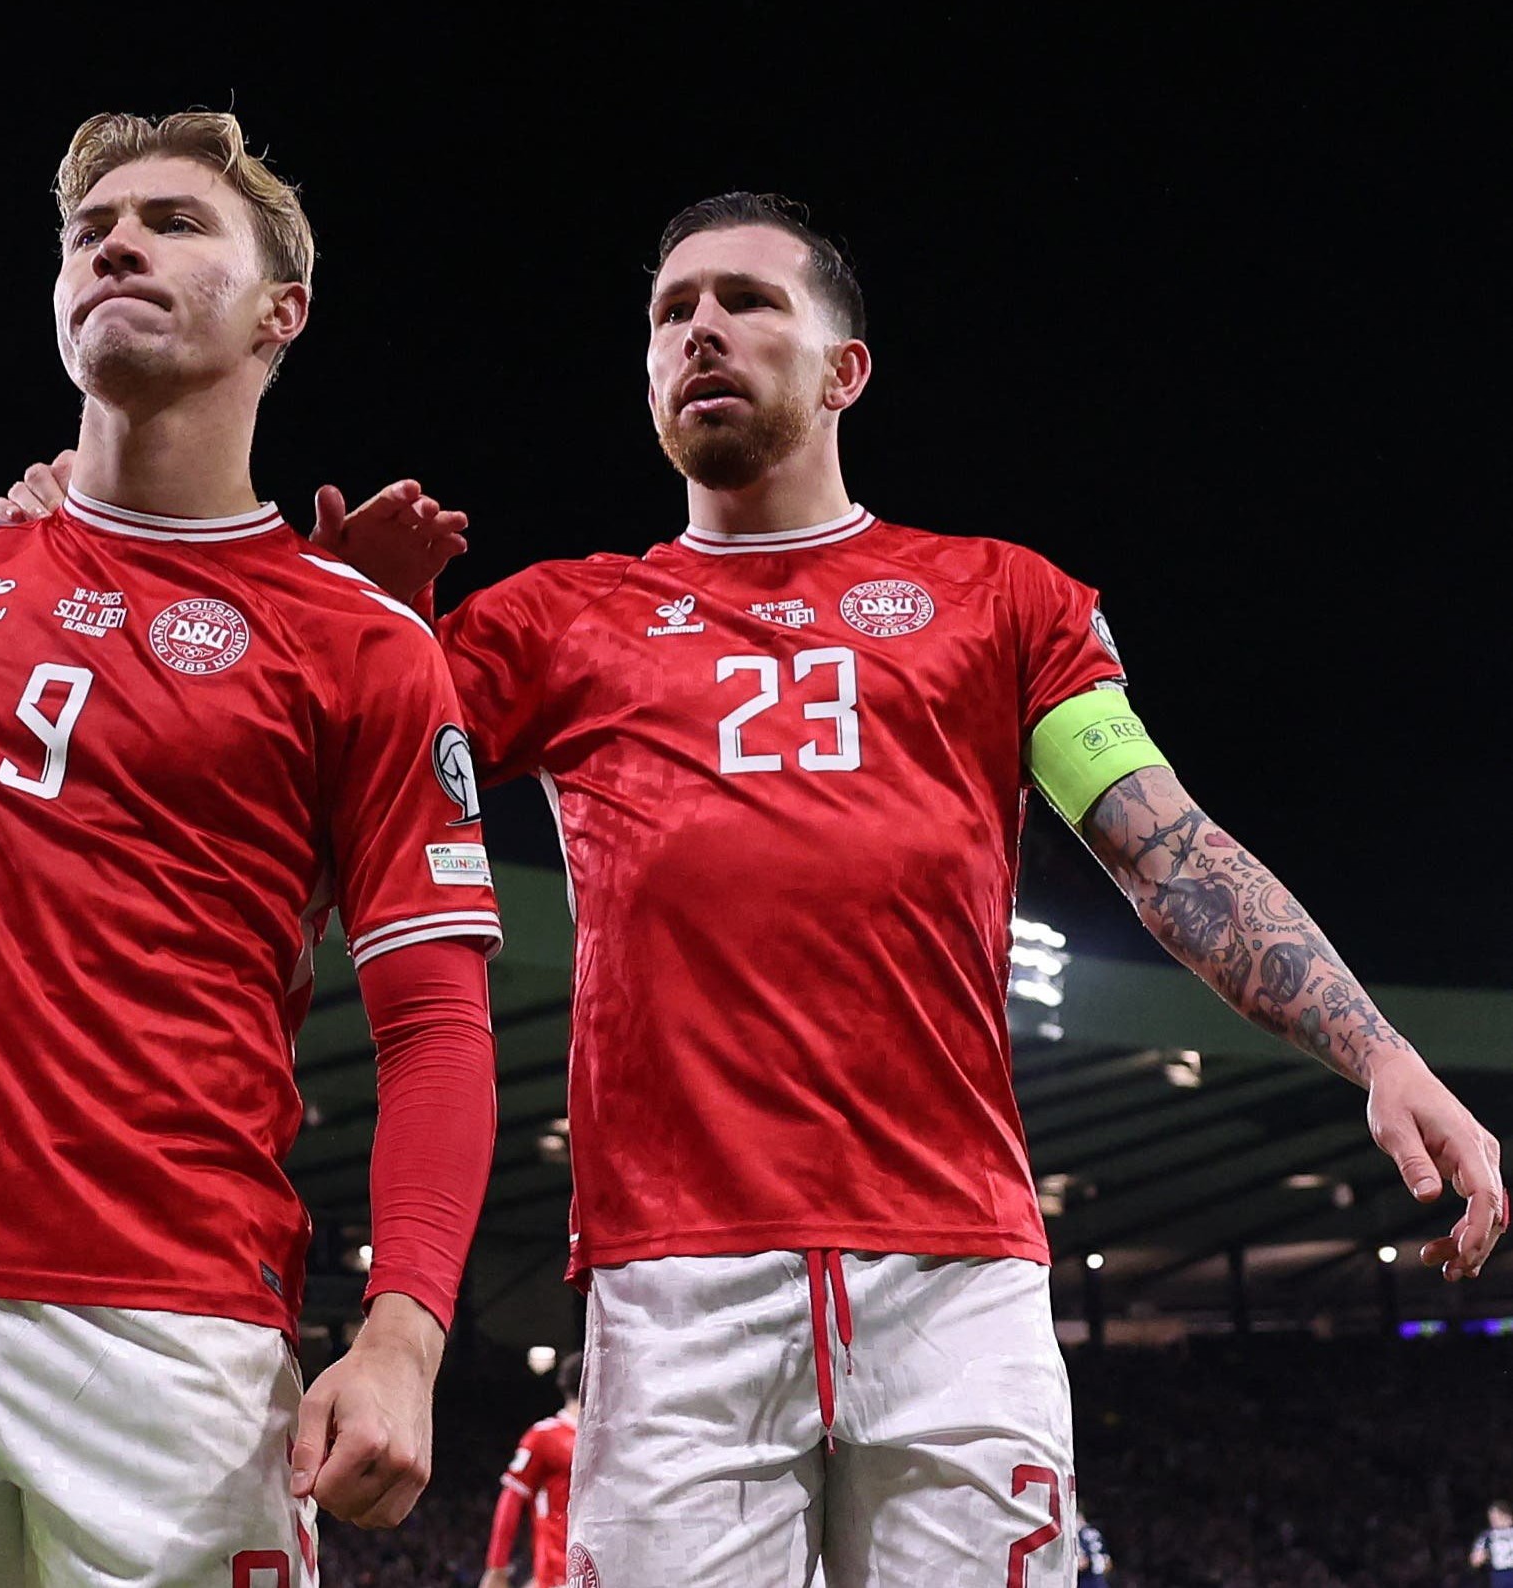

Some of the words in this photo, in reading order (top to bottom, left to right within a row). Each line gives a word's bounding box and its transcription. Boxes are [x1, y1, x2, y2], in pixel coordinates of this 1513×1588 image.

[73, 587, 124, 606] 18-11-2025
[53, 599, 87, 621] SCO
[96, 607, 127, 628] DEN
[786, 607, 815, 624] DEN
[860, 597, 915, 616] DBU
[62, 619, 107, 638] GLASGOW
[169, 619, 230, 650] DBU
[647, 622, 705, 637] hummel
[167, 655, 207, 672] 1889
[716, 646, 861, 774] 23
[1110, 722, 1147, 739] RES
[1006, 1464, 1075, 1588] 2
